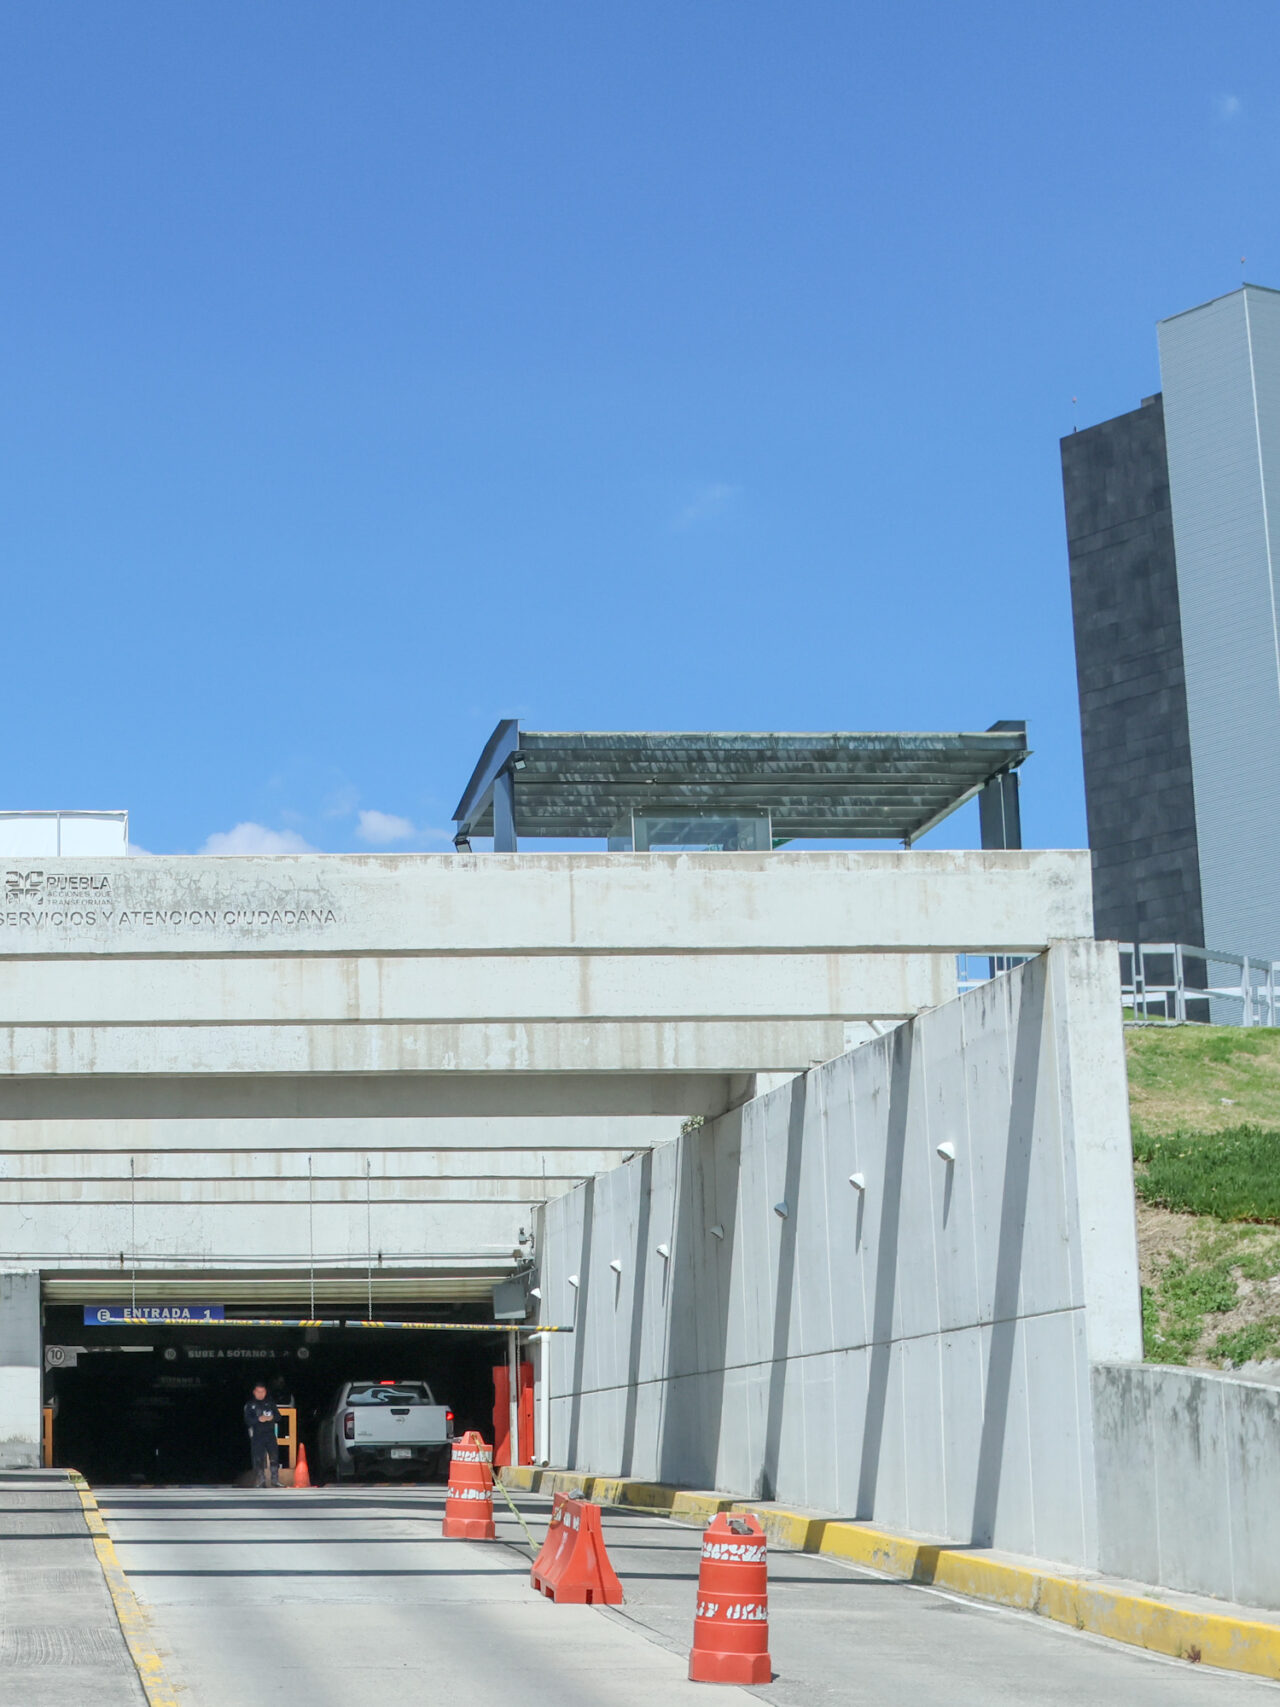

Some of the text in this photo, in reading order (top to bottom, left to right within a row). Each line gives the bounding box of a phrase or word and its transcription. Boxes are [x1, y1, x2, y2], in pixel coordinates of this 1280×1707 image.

[46, 876, 112, 889] PUEBLA
[102, 911, 113, 925] Y
[119, 910, 217, 926] ATENCION
[223, 910, 337, 925] CIUDADANA
[123, 1308, 191, 1318] ENTRADA
[203, 1310, 213, 1320] 1
[51, 1350, 63, 1361] 10
[188, 1350, 214, 1358] SUBE
[217, 1350, 225, 1358] A
